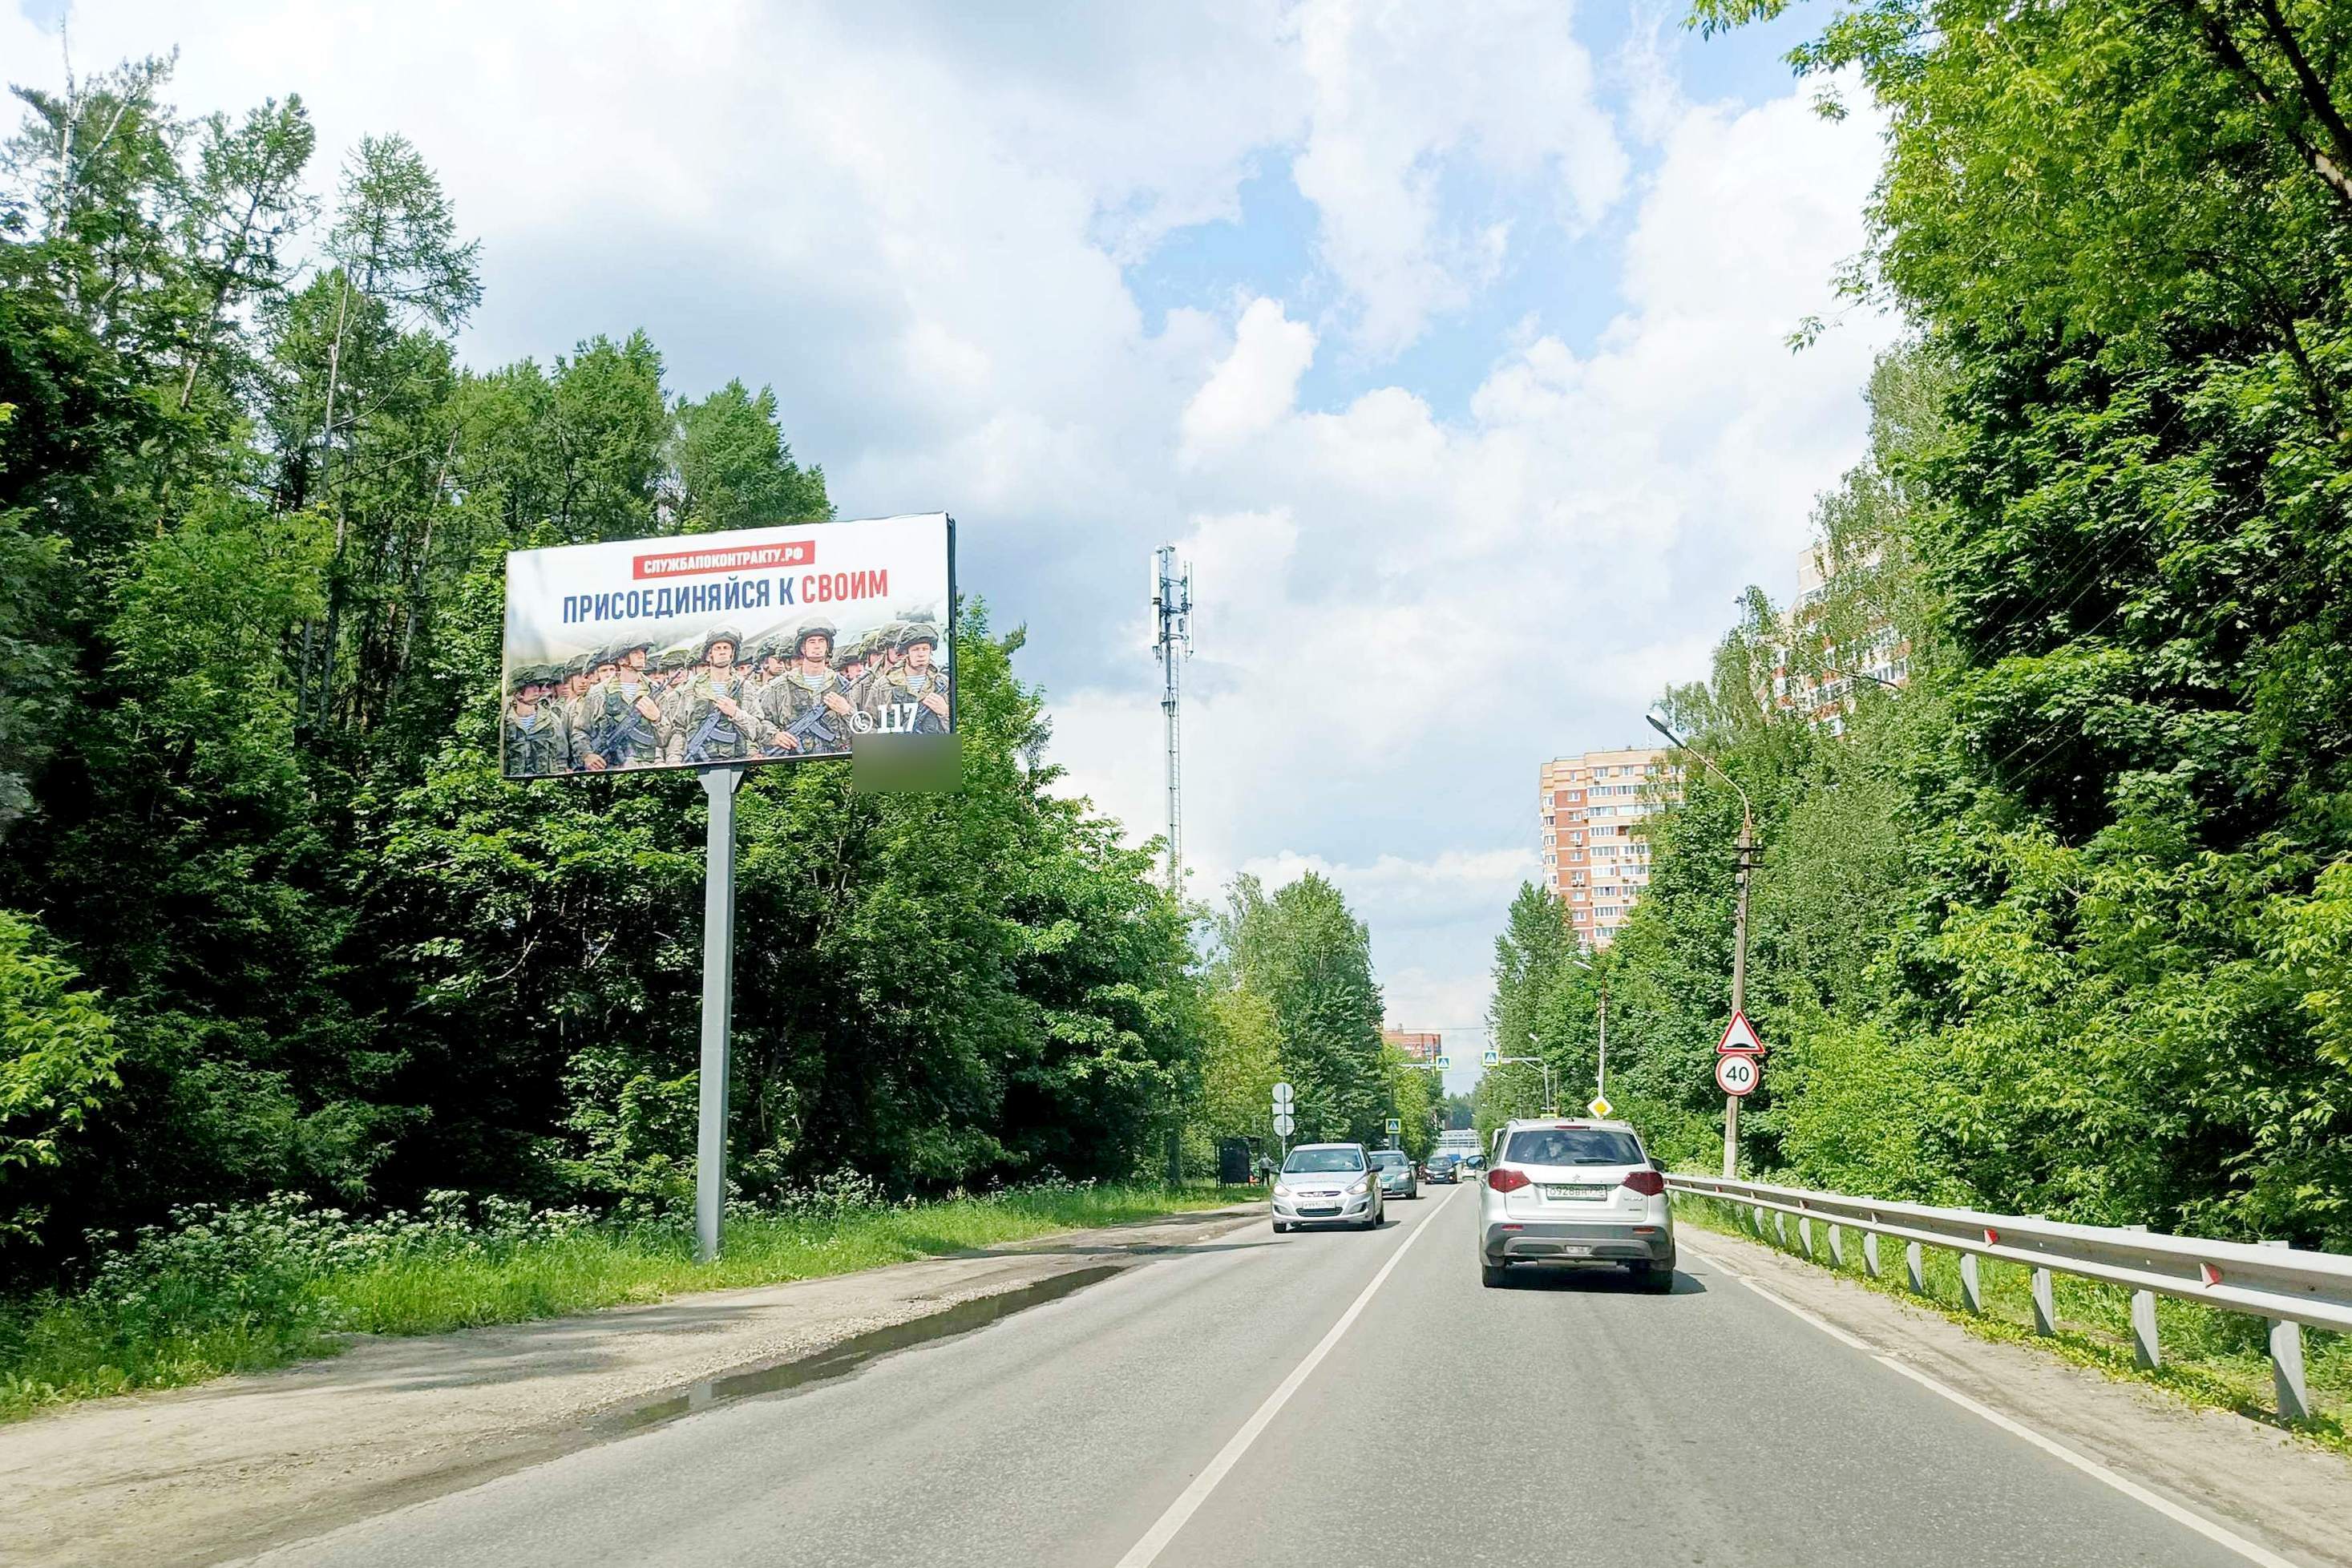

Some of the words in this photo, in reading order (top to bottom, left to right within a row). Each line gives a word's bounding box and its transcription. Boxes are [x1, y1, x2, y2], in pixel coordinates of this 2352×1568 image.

[644, 547, 803, 574] СЛУЖБАПОКОНТРАКТУ.РФ
[563, 576, 770, 623] ПРИСОЕДИНЯЙСЯ
[779, 577, 794, 605] К
[802, 569, 887, 603] СВОИМ
[877, 702, 919, 733] 117
[1726, 1066, 1749, 1082] 40
